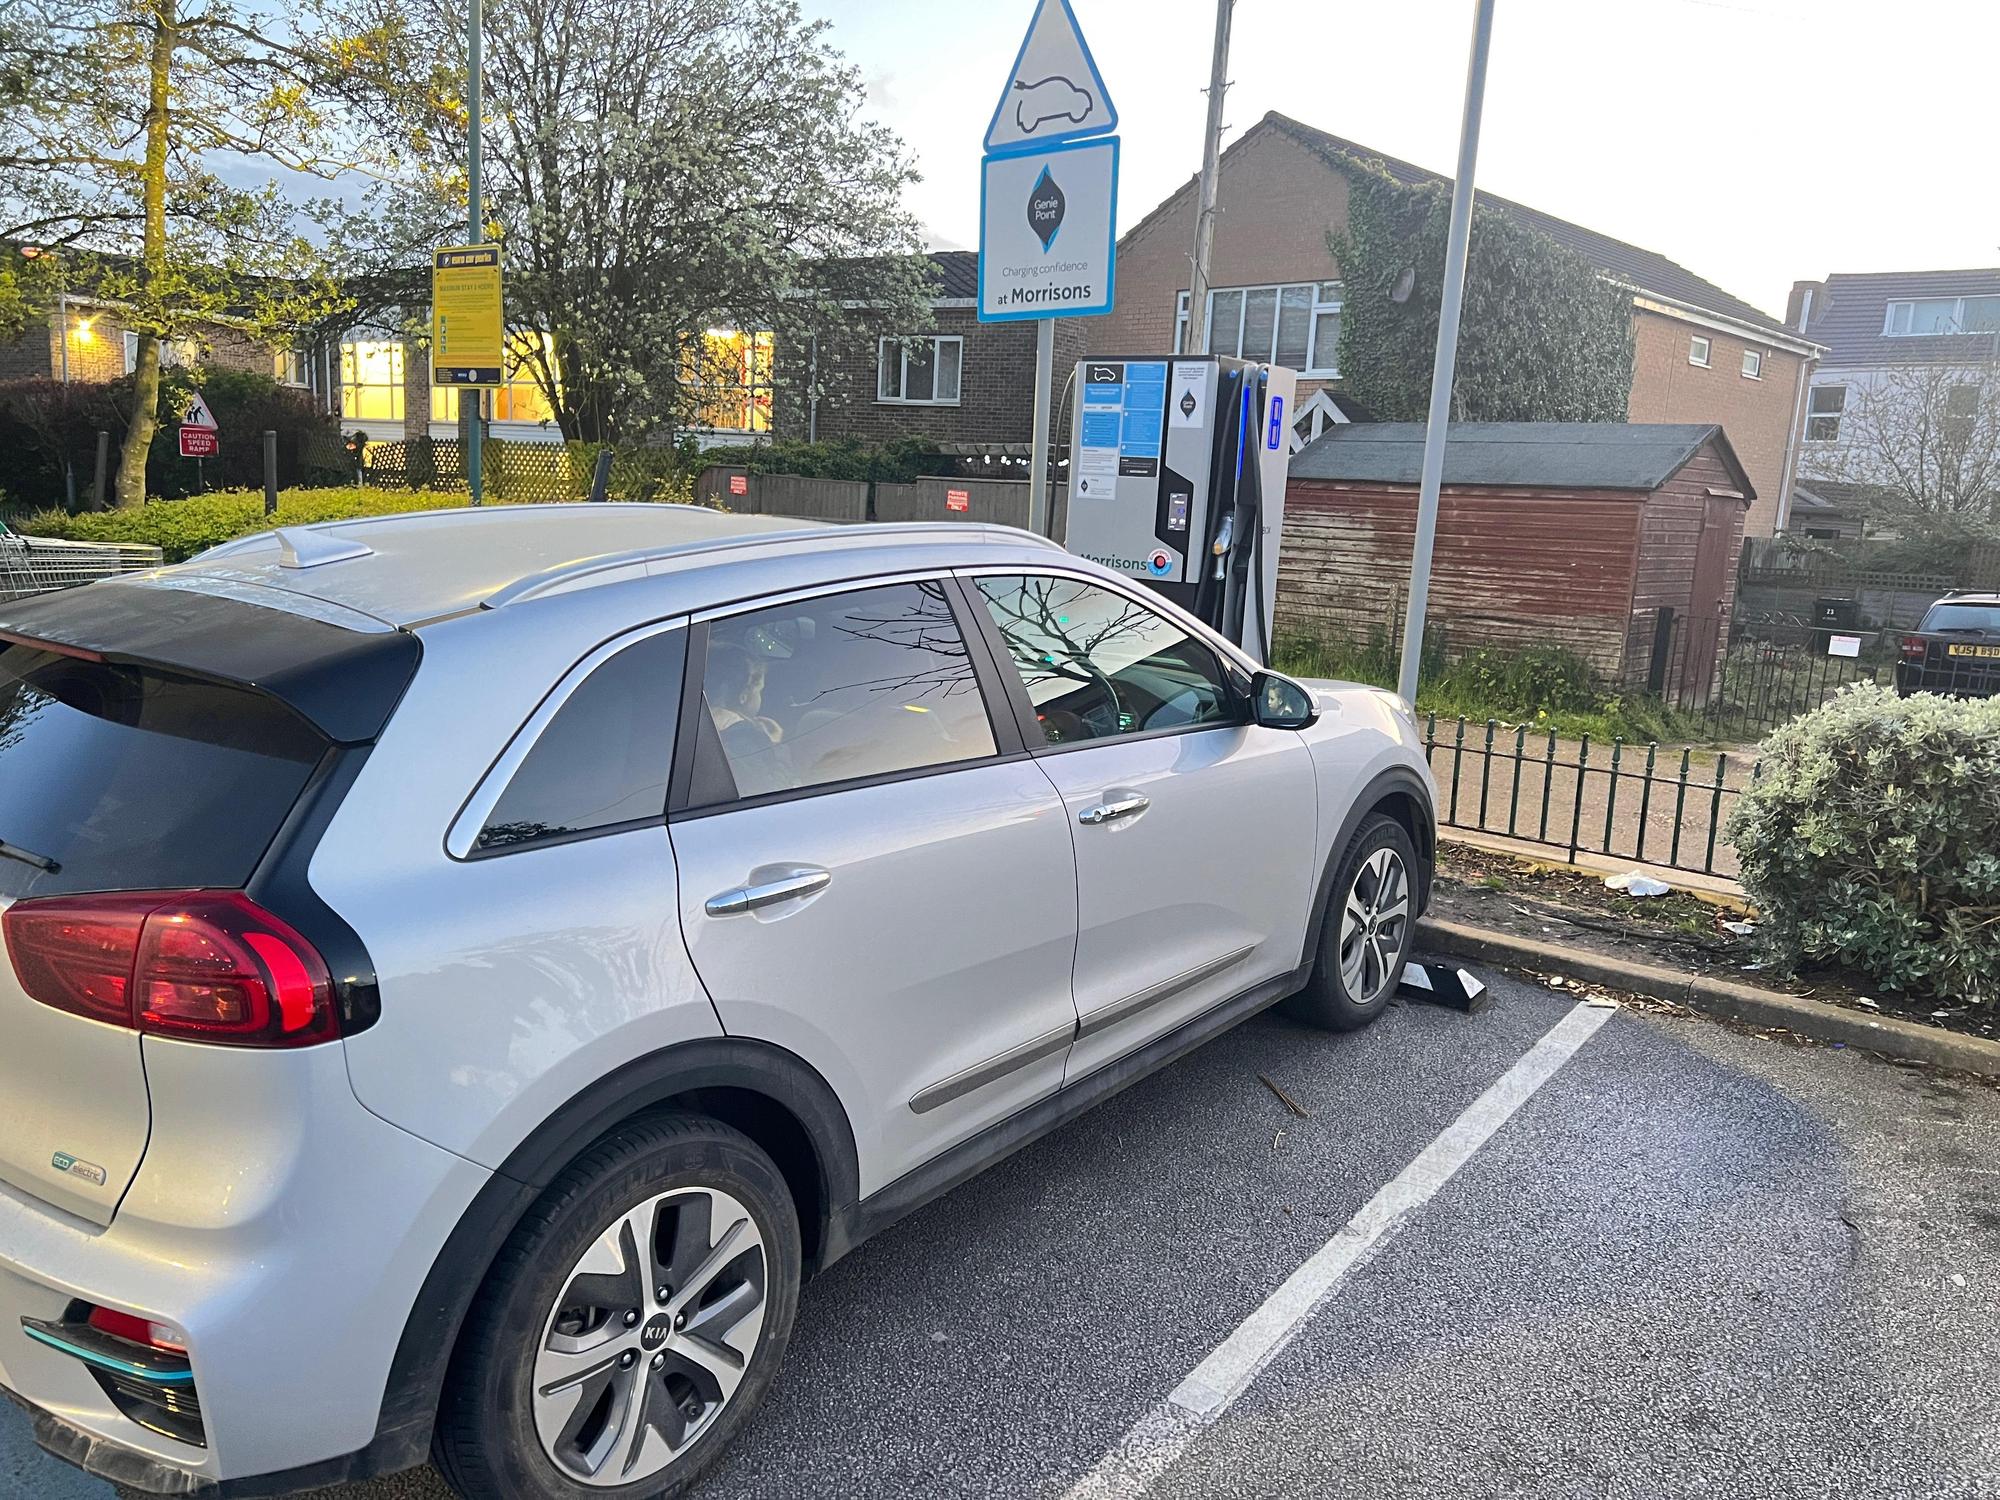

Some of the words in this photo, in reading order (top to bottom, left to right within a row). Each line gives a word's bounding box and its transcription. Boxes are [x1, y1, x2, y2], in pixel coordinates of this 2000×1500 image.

[1034, 196, 1058, 210] Genie
[1035, 210, 1056, 220] Point
[1002, 264, 1039, 278] Charging
[1039, 261, 1088, 274] confidence
[997, 294, 1008, 305] at
[1011, 282, 1091, 303] Morrisons
[72, 1164, 100, 1181] electric
[645, 1326, 667, 1339] KIA
